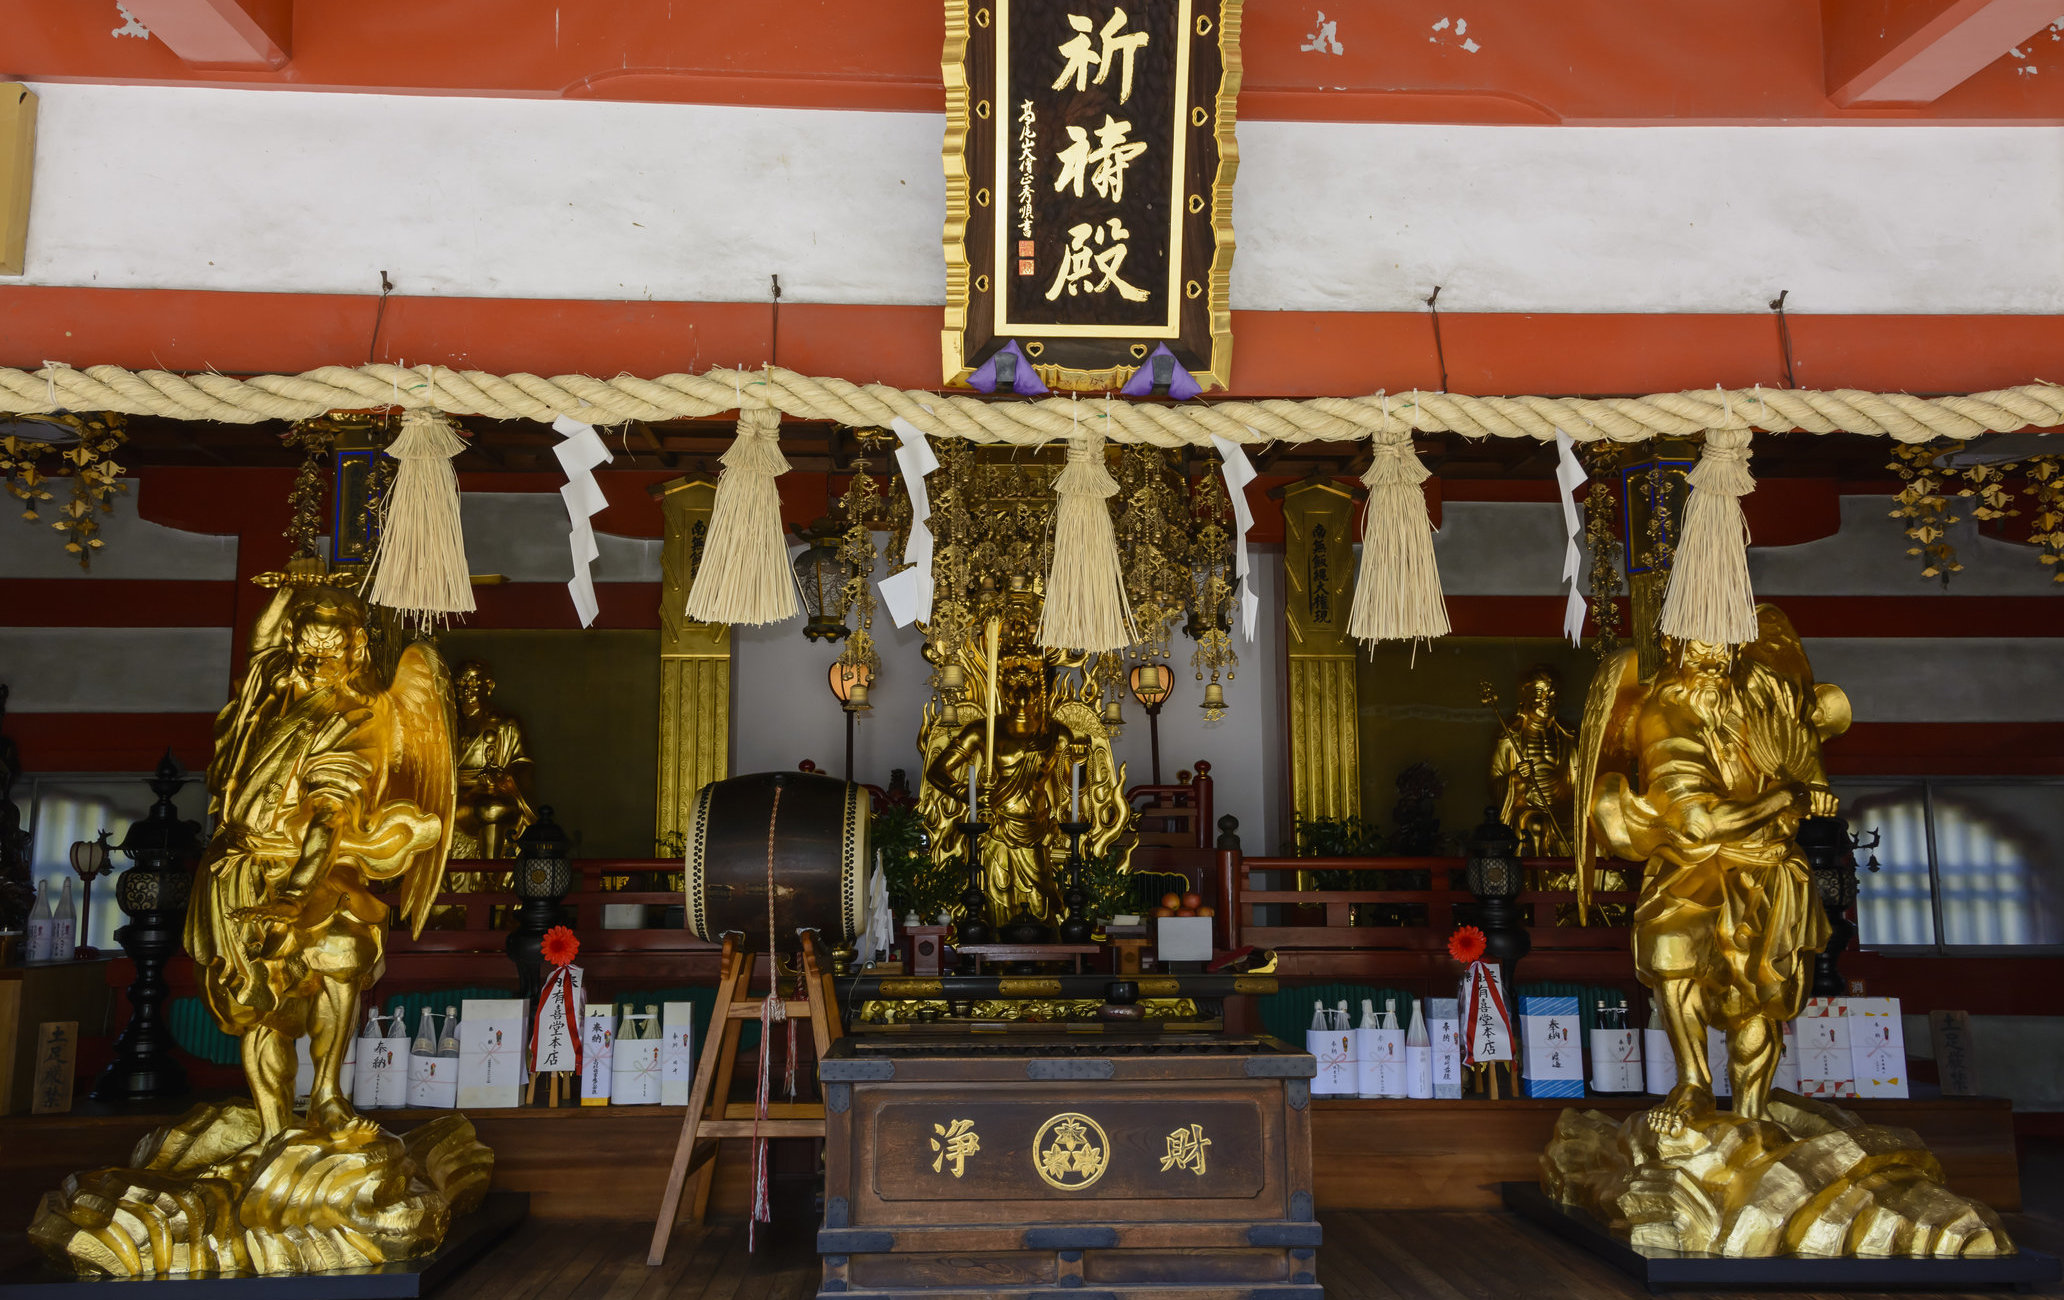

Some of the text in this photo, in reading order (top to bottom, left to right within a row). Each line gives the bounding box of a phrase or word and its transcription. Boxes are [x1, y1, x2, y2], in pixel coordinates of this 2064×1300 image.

[544, 989, 565, 1067] 有喜堂本店
[591, 1021, 603, 1044] 奉納
[1478, 985, 1497, 1056] 有喜堂本店
[1547, 1018, 1561, 1041] 奉納
[371, 1040, 388, 1069] 奉納
